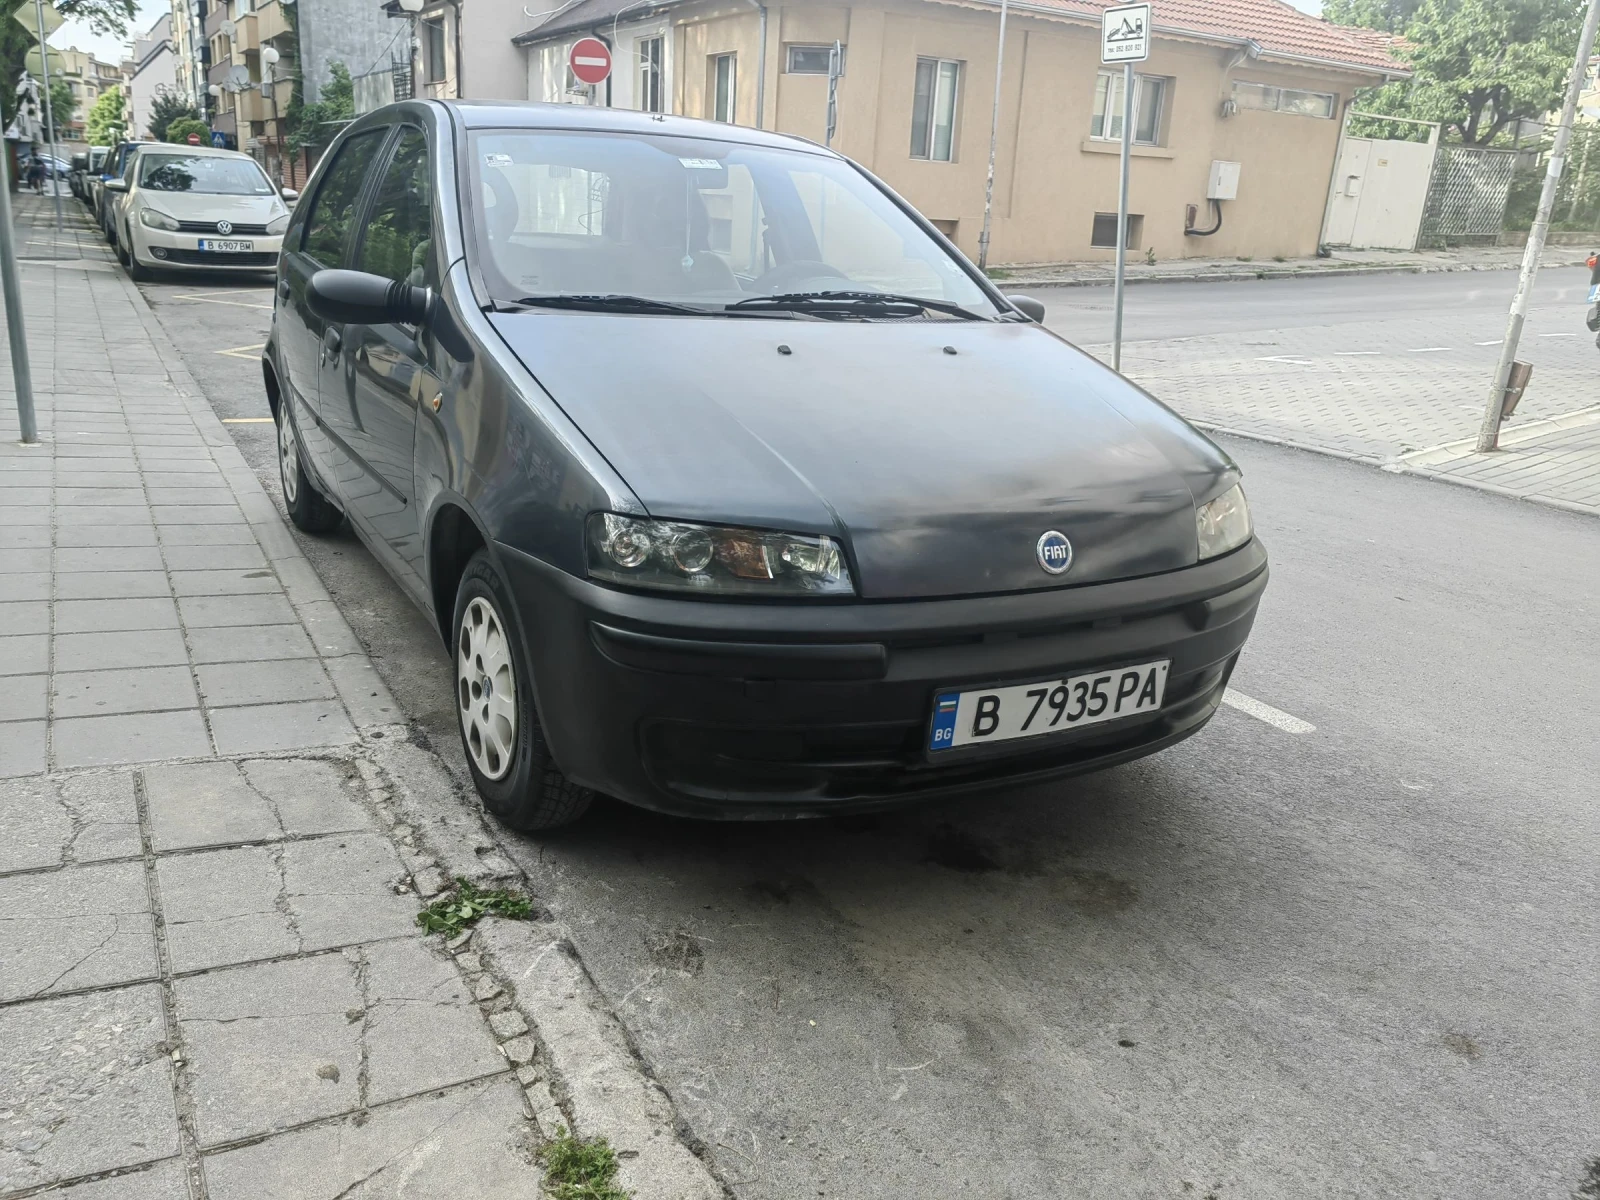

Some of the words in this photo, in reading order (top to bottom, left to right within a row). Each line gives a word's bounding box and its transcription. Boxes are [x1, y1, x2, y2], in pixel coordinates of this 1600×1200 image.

[1043, 544, 1067, 560] FIAT
[972, 694, 1001, 737] B
[934, 727, 952, 741] BG
